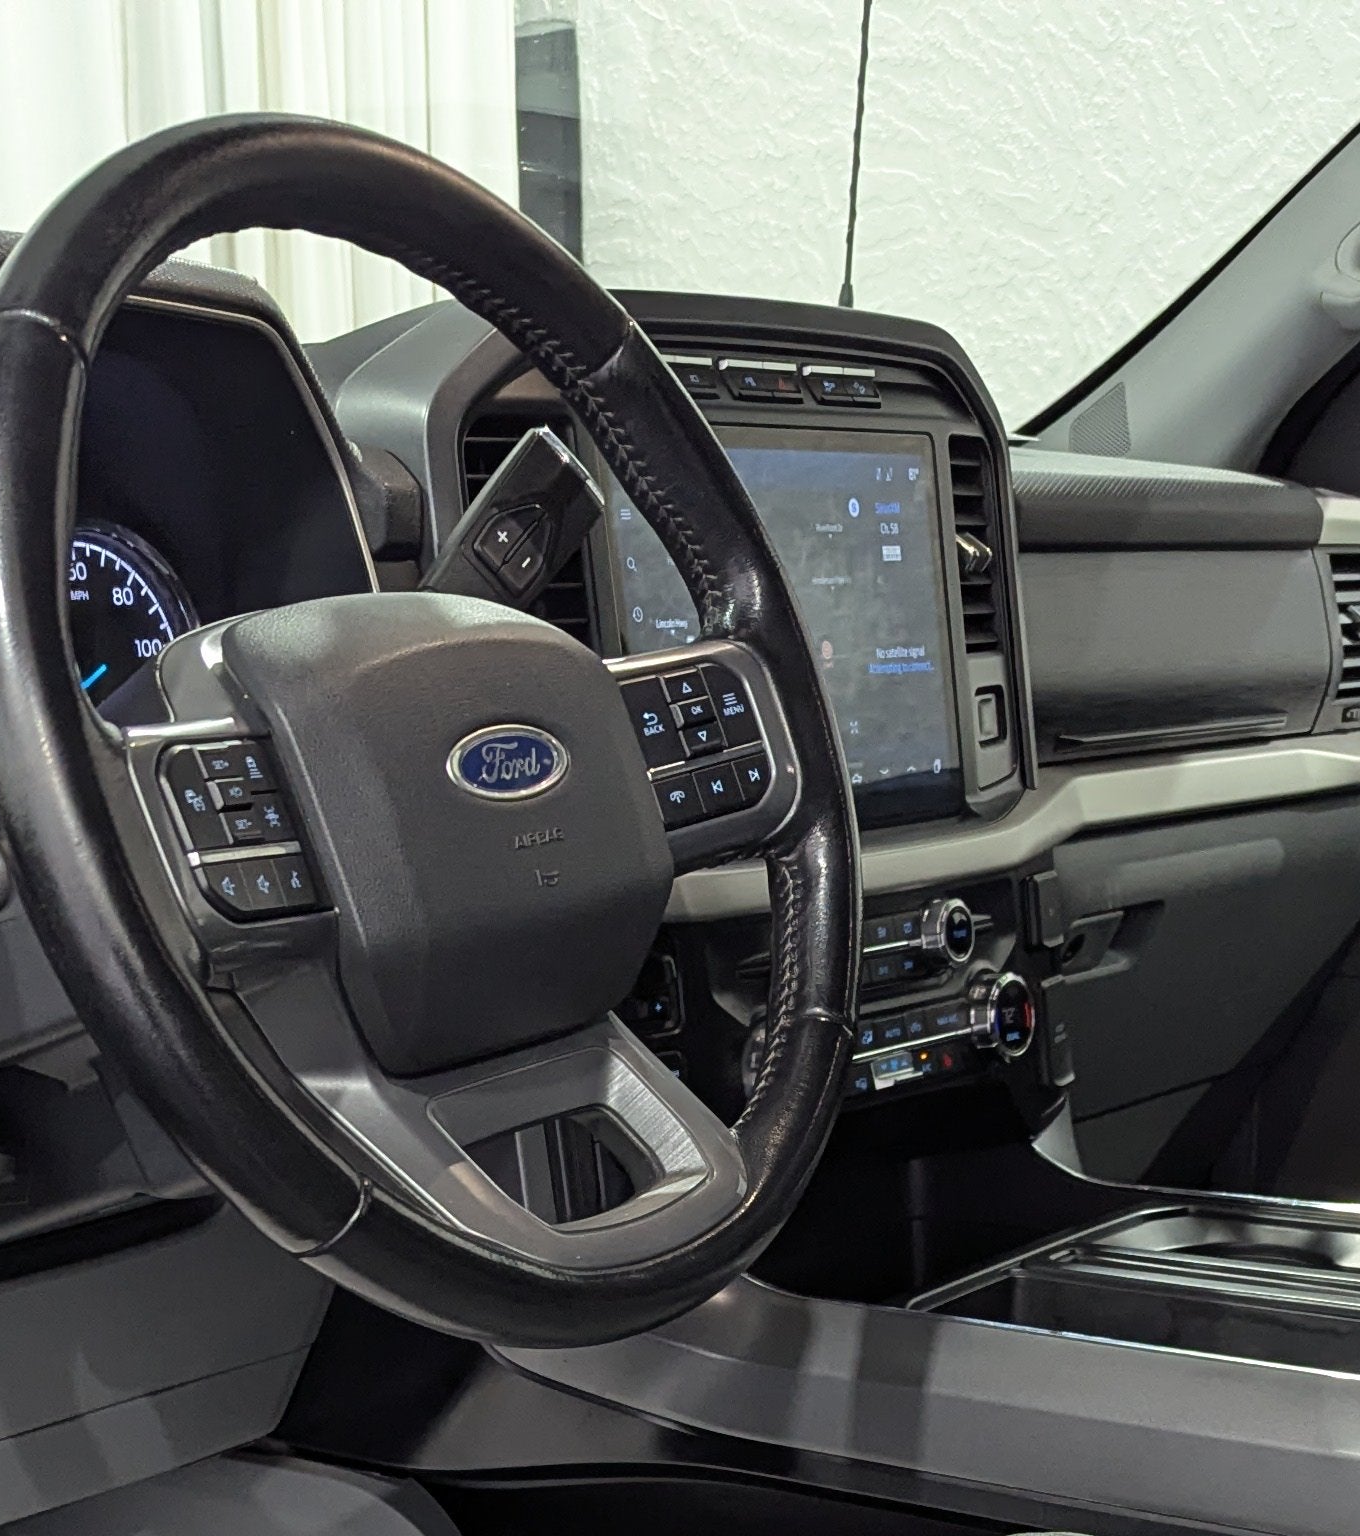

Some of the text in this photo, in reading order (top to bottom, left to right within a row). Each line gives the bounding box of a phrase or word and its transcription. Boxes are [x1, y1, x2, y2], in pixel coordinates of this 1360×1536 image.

[112, 587, 134, 606] 80
[135, 638, 162, 657] 100
[690, 705, 703, 715] OK
[723, 704, 745, 716] MENU
[643, 724, 665, 737] BACK
[479, 741, 541, 784] Ford
